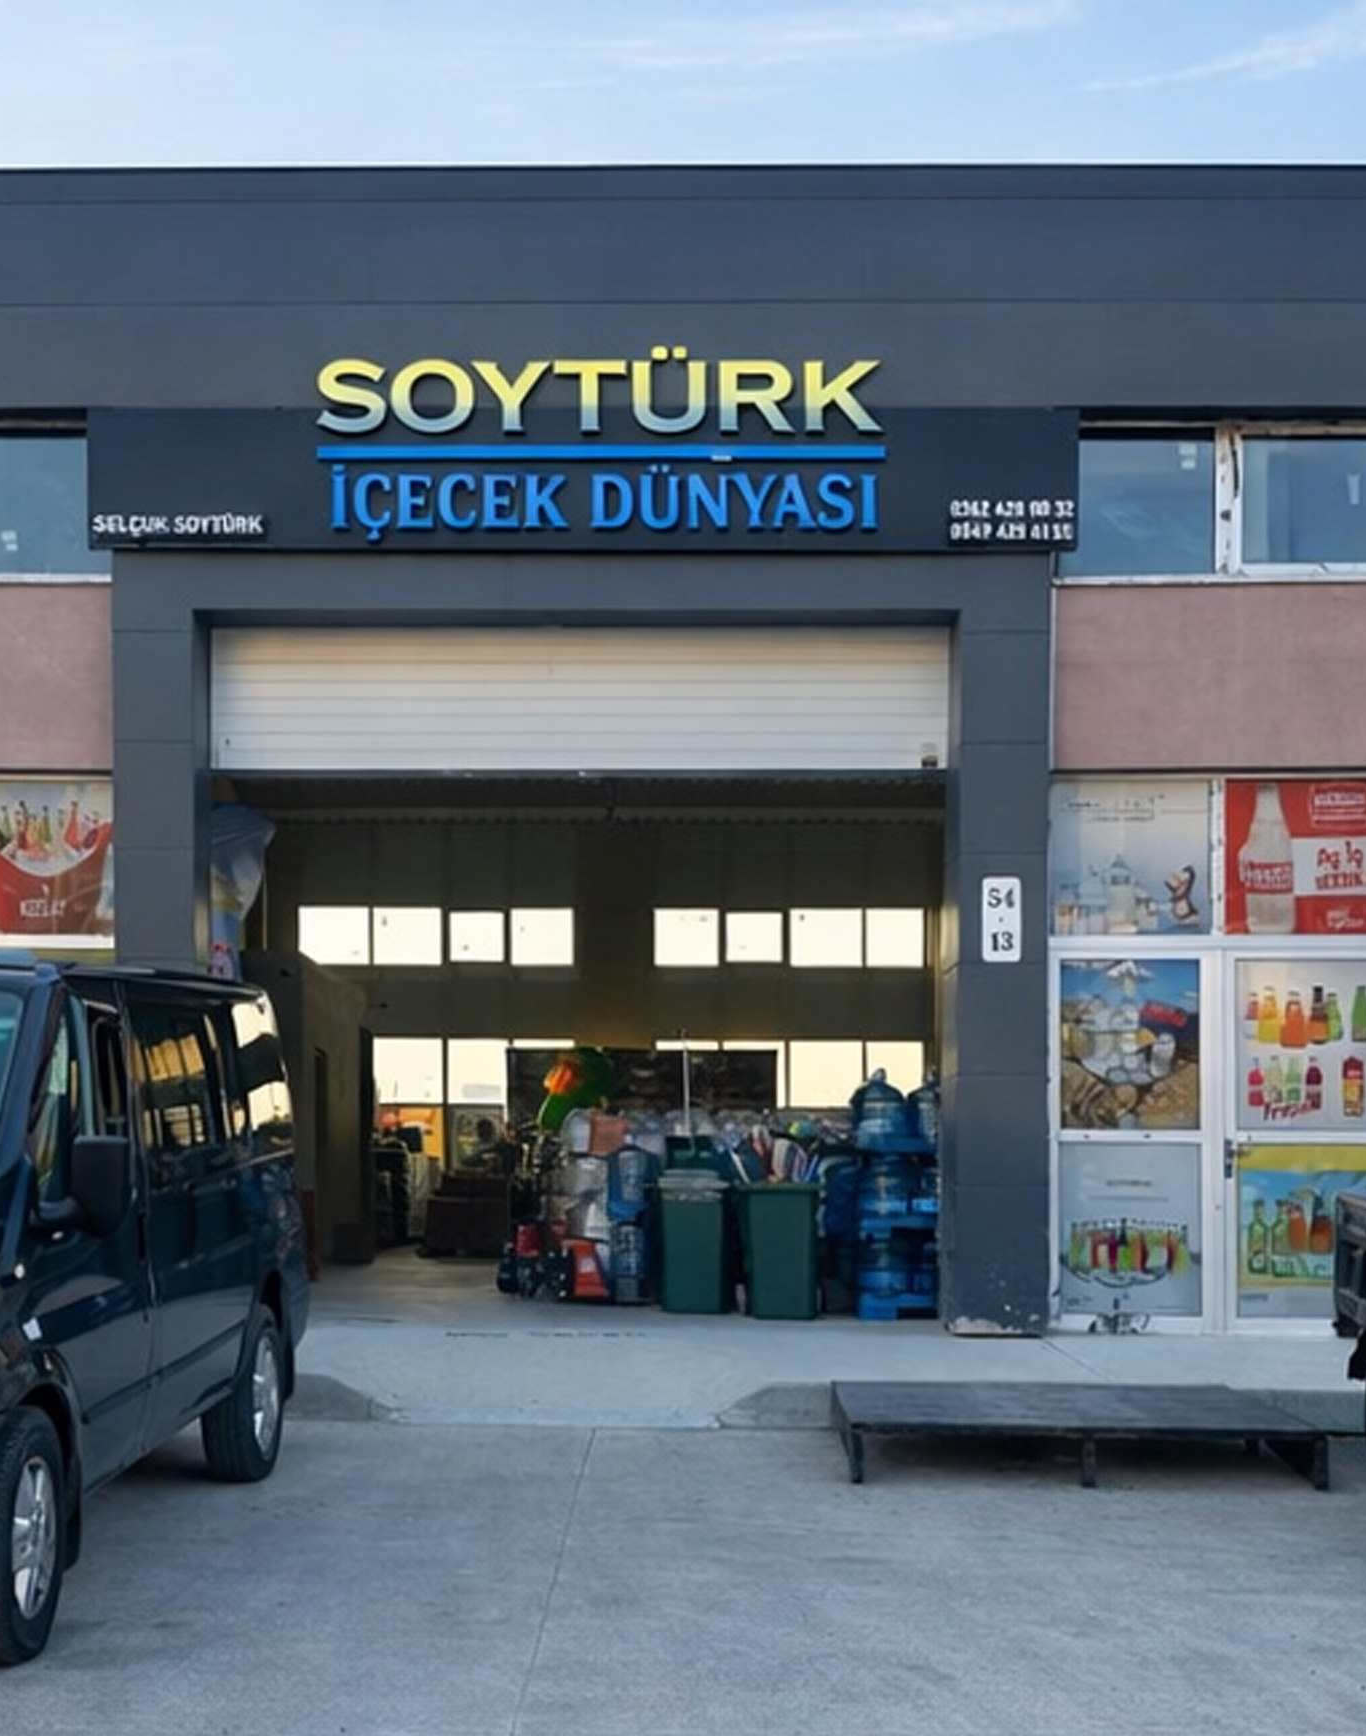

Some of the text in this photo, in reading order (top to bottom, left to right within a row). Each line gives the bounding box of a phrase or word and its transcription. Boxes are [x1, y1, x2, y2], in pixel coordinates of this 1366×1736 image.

[316, 346, 884, 434] SOYTÜRK
[92, 514, 171, 537] SELÇUK
[330, 464, 879, 541] İÇECEK DÜNYASI
[991, 931, 1014, 952] 13
